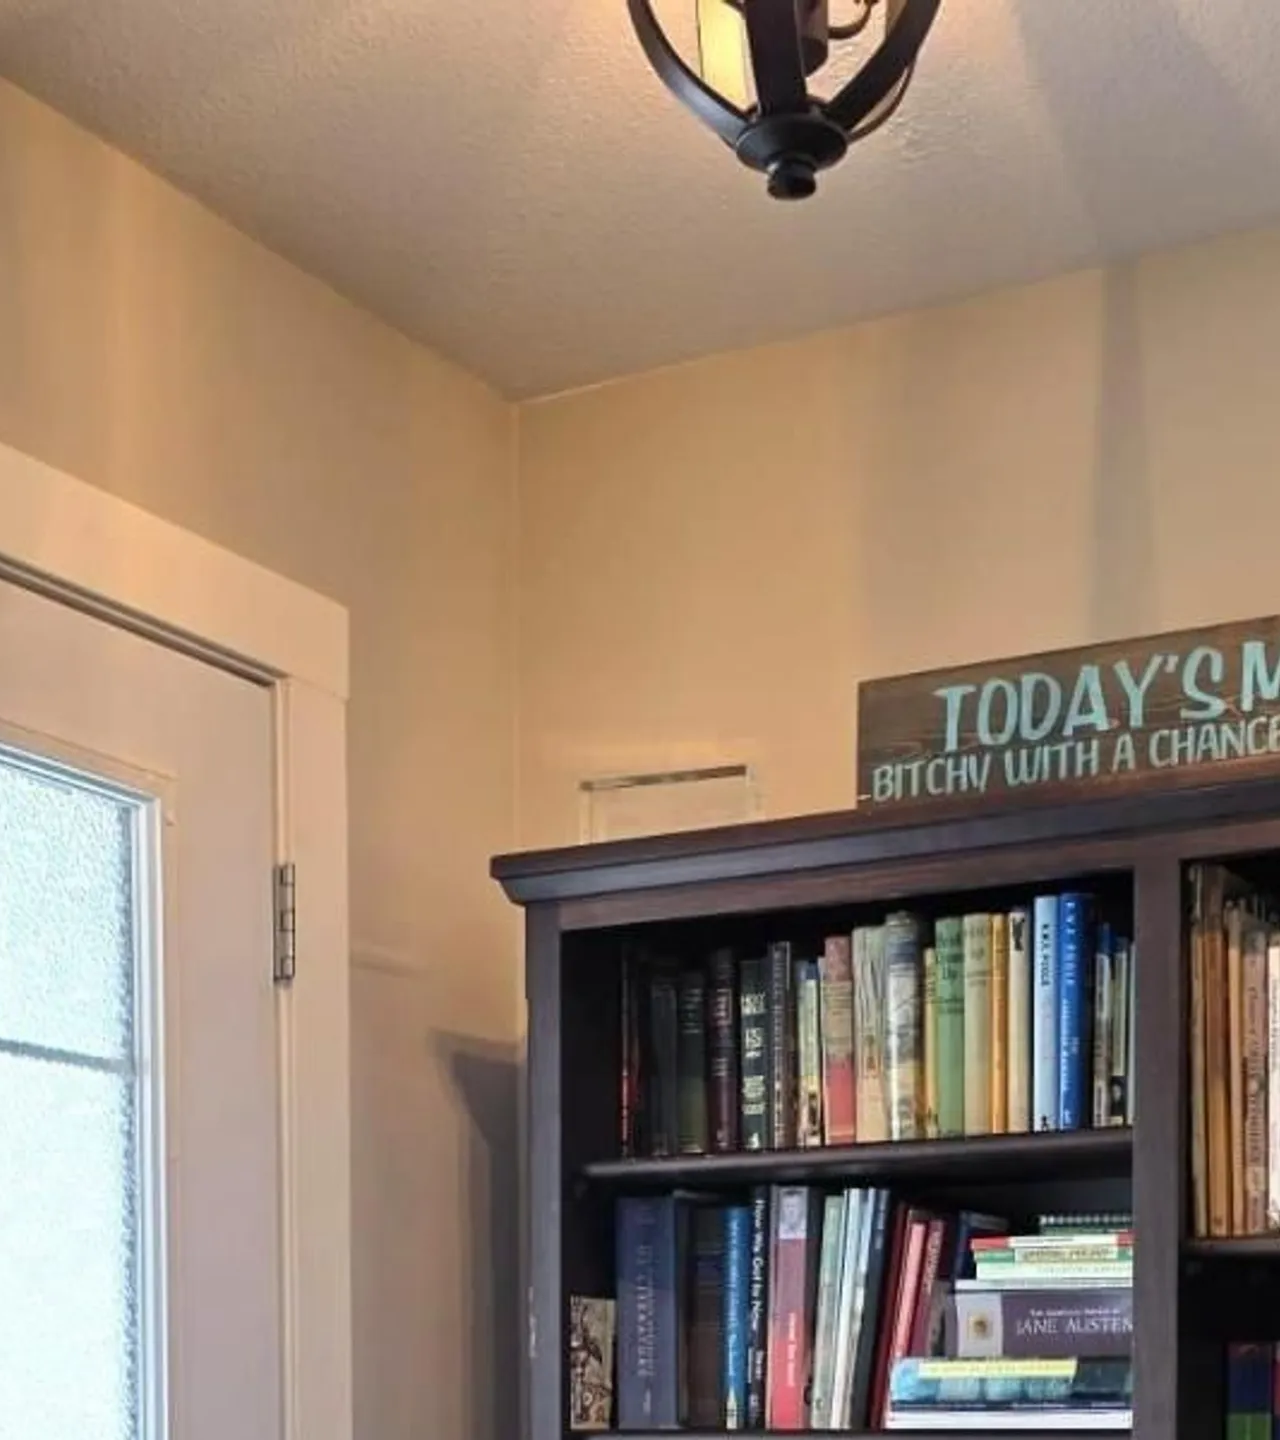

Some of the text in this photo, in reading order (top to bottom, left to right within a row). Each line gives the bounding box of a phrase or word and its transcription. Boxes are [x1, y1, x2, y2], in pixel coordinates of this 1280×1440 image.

[934, 646, 1223, 754] TODAY'S
[871, 752, 991, 803] BITCHY
[1005, 739, 1100, 786] WITH
[1112, 731, 1136, 771] A
[753, 1199, 765, 1229] How
[1015, 1317, 1133, 1336] JANE AUSTEN
